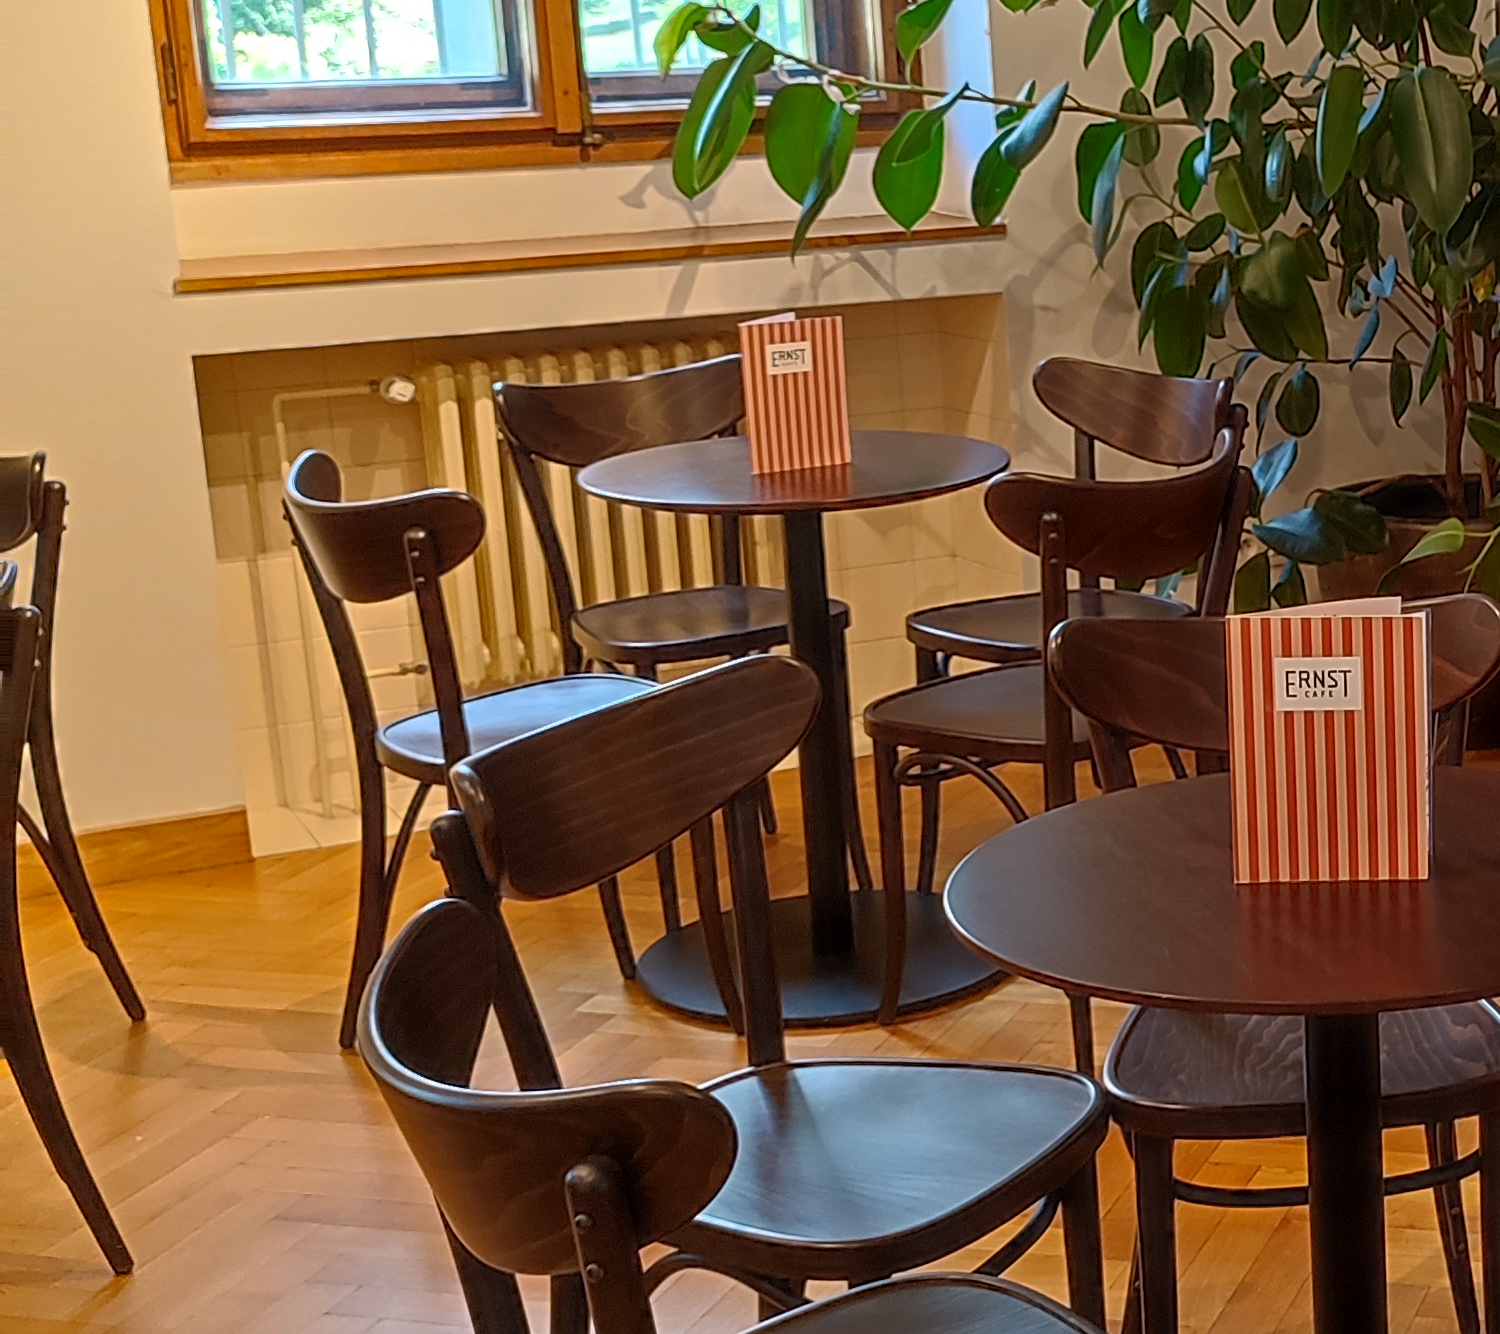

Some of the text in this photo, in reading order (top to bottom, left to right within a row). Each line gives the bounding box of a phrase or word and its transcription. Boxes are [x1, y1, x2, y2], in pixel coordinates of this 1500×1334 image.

[771, 348, 806, 367] ERNST
[1285, 669, 1352, 698] ERNST
[1304, 690, 1334, 698] CAFE
